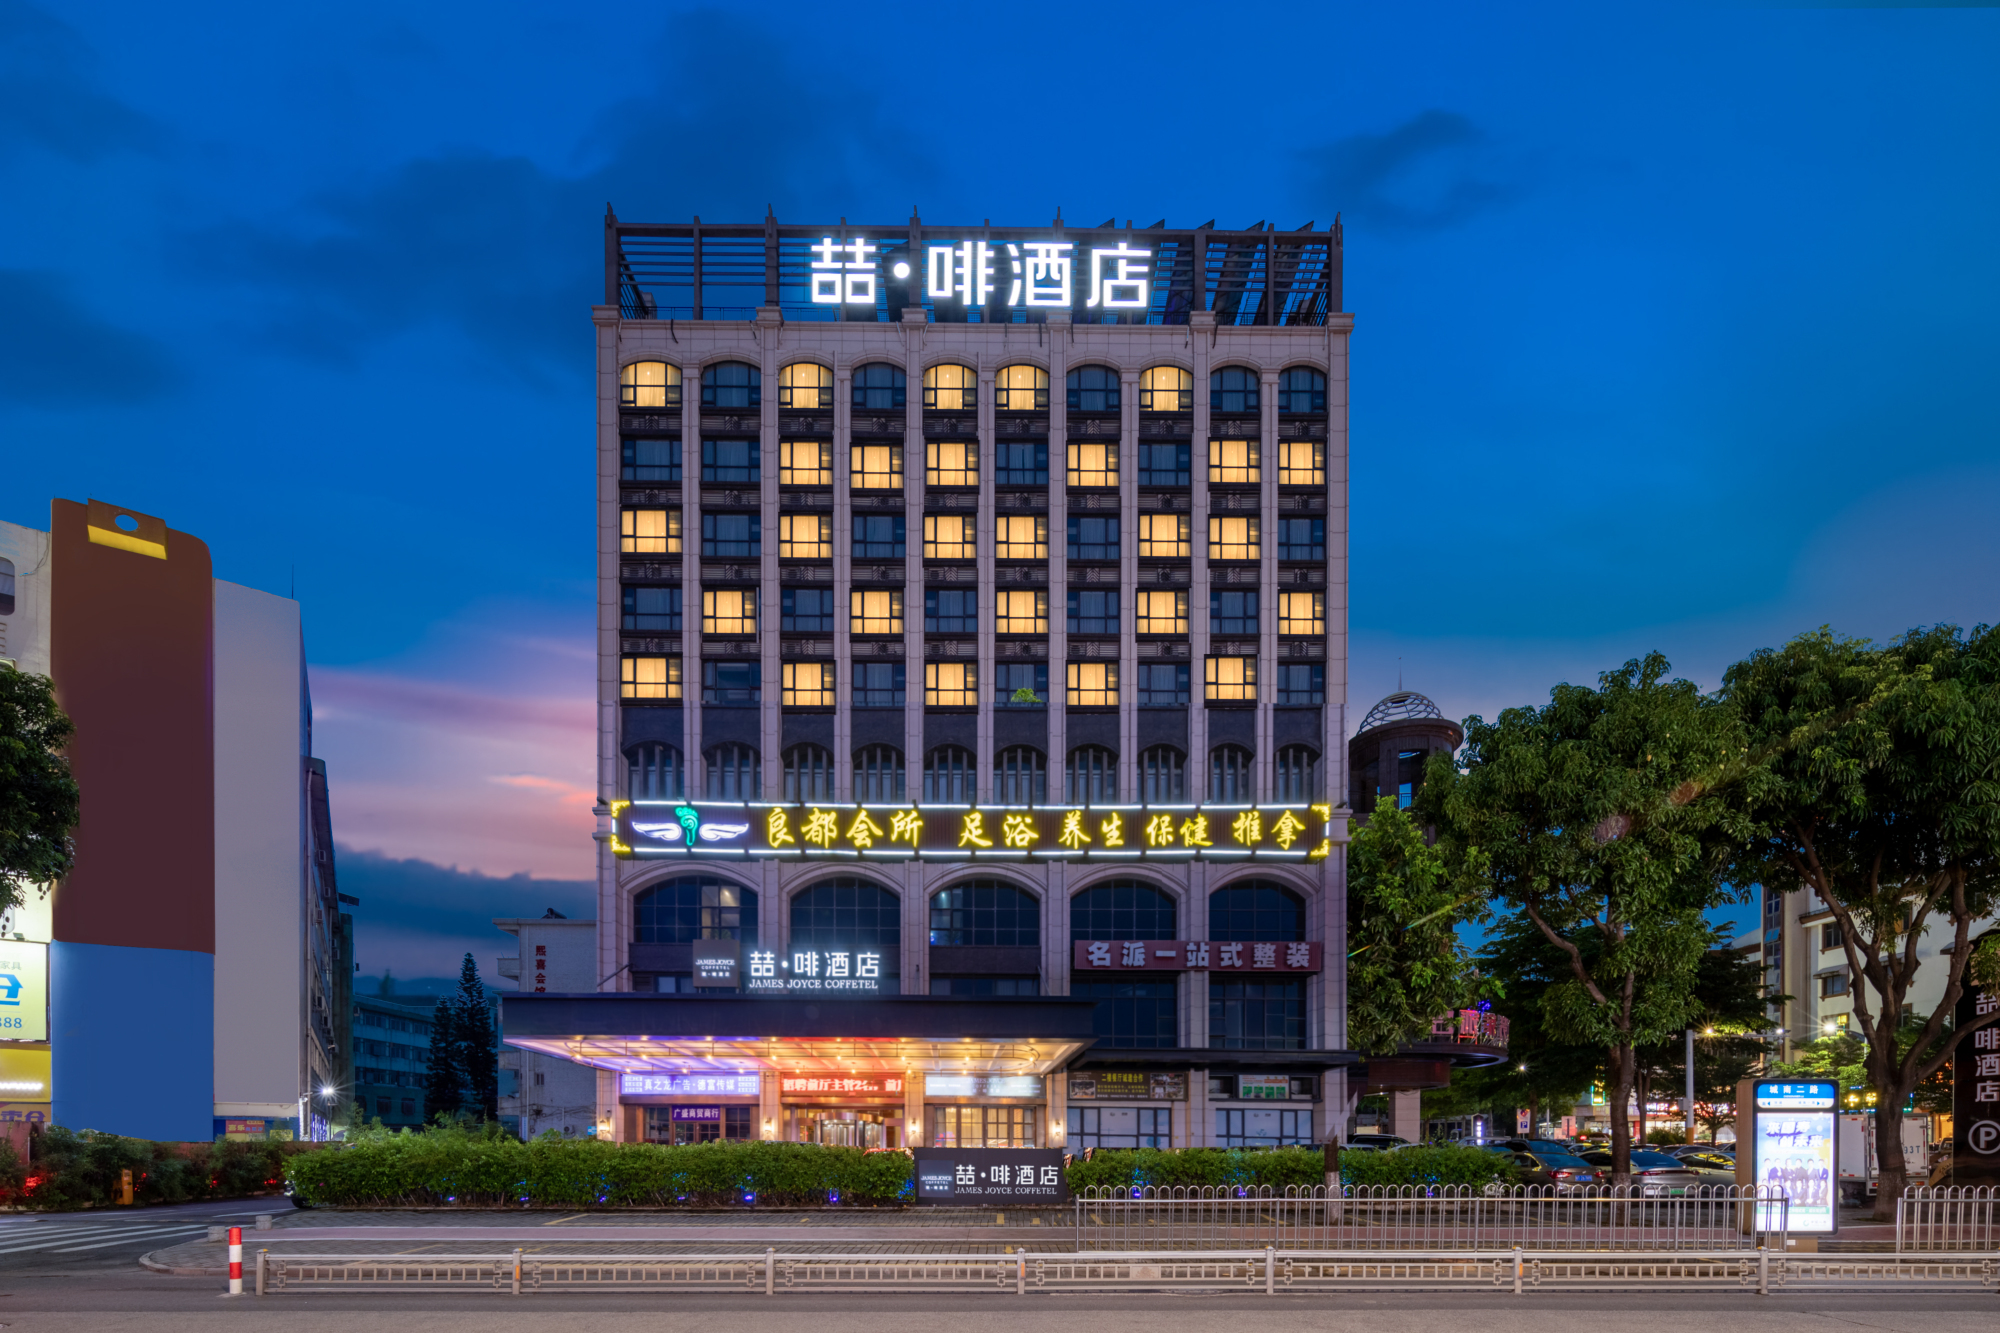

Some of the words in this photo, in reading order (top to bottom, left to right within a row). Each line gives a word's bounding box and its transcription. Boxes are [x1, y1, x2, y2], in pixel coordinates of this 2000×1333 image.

[811, 236, 1151, 307] 喆·啡酒店
[766, 806, 924, 849] 良都会所
[958, 810, 1039, 848] 足浴
[1058, 809, 1125, 850] 养生
[1146, 812, 1214, 847] 保健
[1232, 809, 1306, 850] 推拿
[750, 951, 880, 977] 喆·啡酒店
[1087, 941, 1310, 968] 名派一站式整装
[749, 979, 784, 988] JAMES
[787, 979, 821, 988] JOYCE
[825, 979, 878, 989] COFFETEL
[1769, 1084, 1818, 1094] 城南二路
[674, 1108, 719, 1118] 广盛商贸商行
[1979, 1127, 1998, 1149] P
[956, 1164, 1058, 1185] 喆·啡酒店
